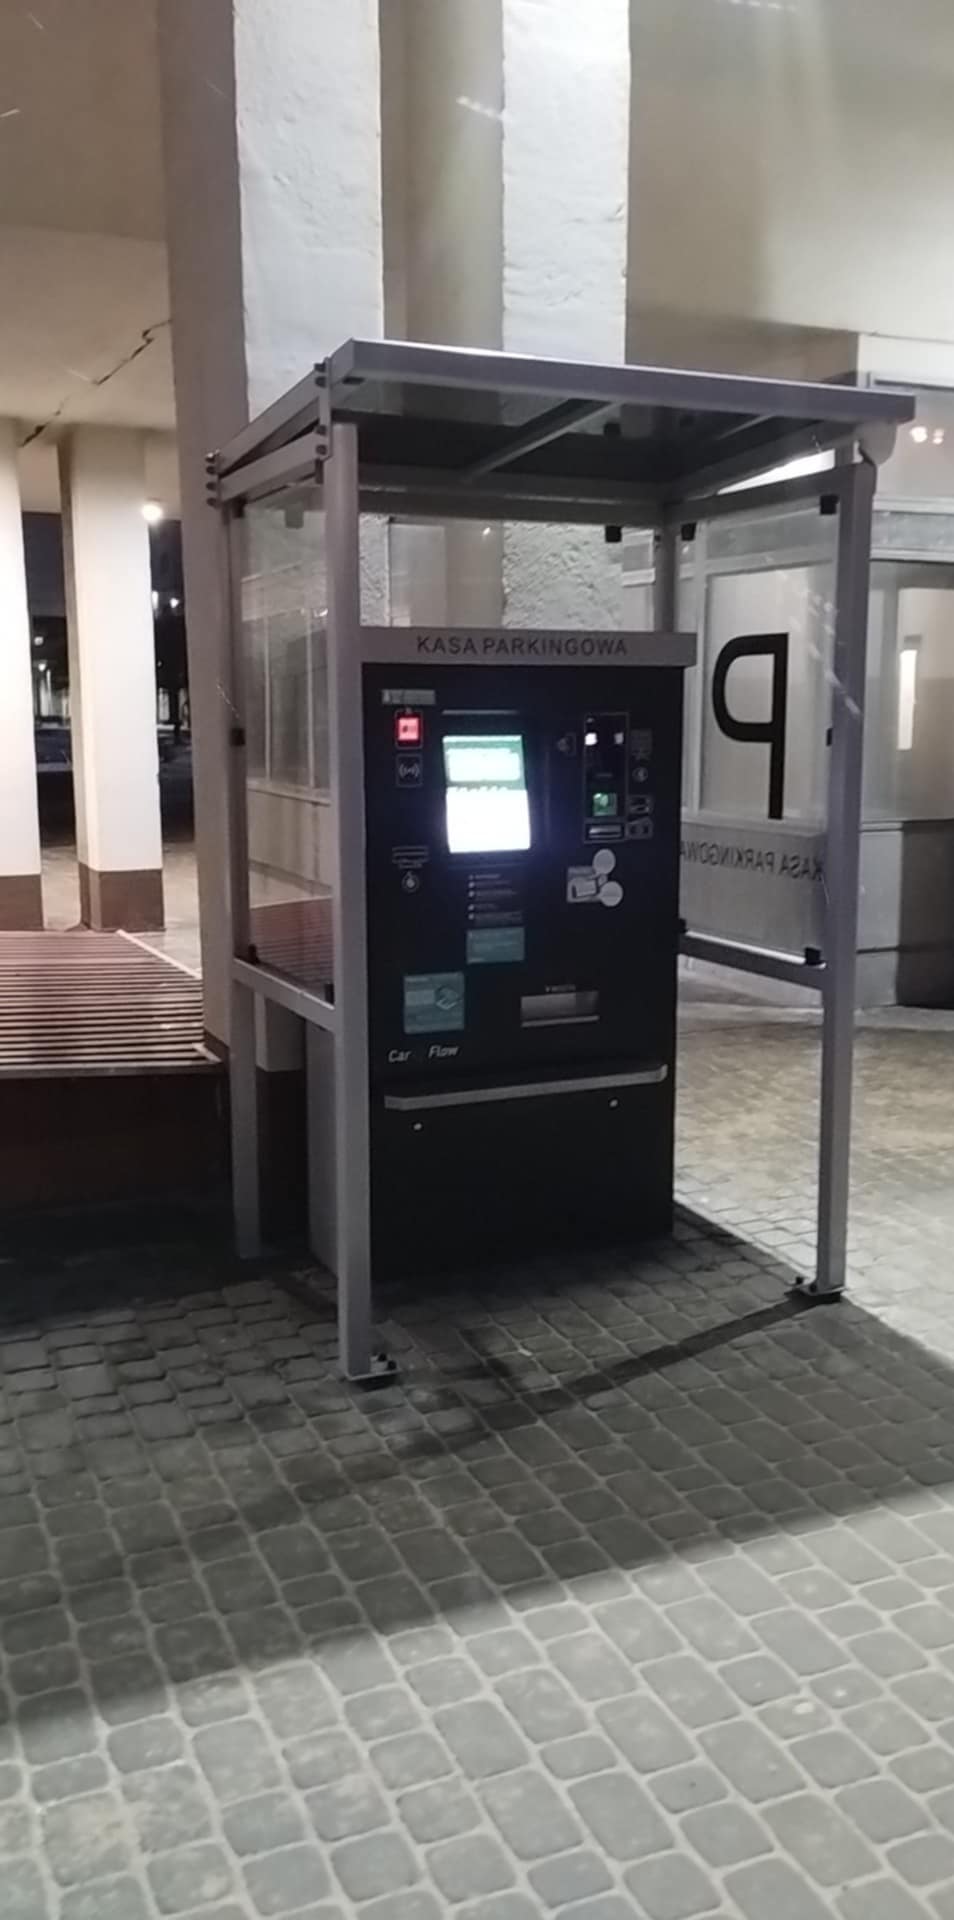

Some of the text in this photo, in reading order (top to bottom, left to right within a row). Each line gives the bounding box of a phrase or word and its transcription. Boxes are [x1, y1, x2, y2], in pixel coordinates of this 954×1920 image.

[417, 636, 627, 657] KASA PARKINGOWA
[388, 1045, 459, 1062] Car Flow
